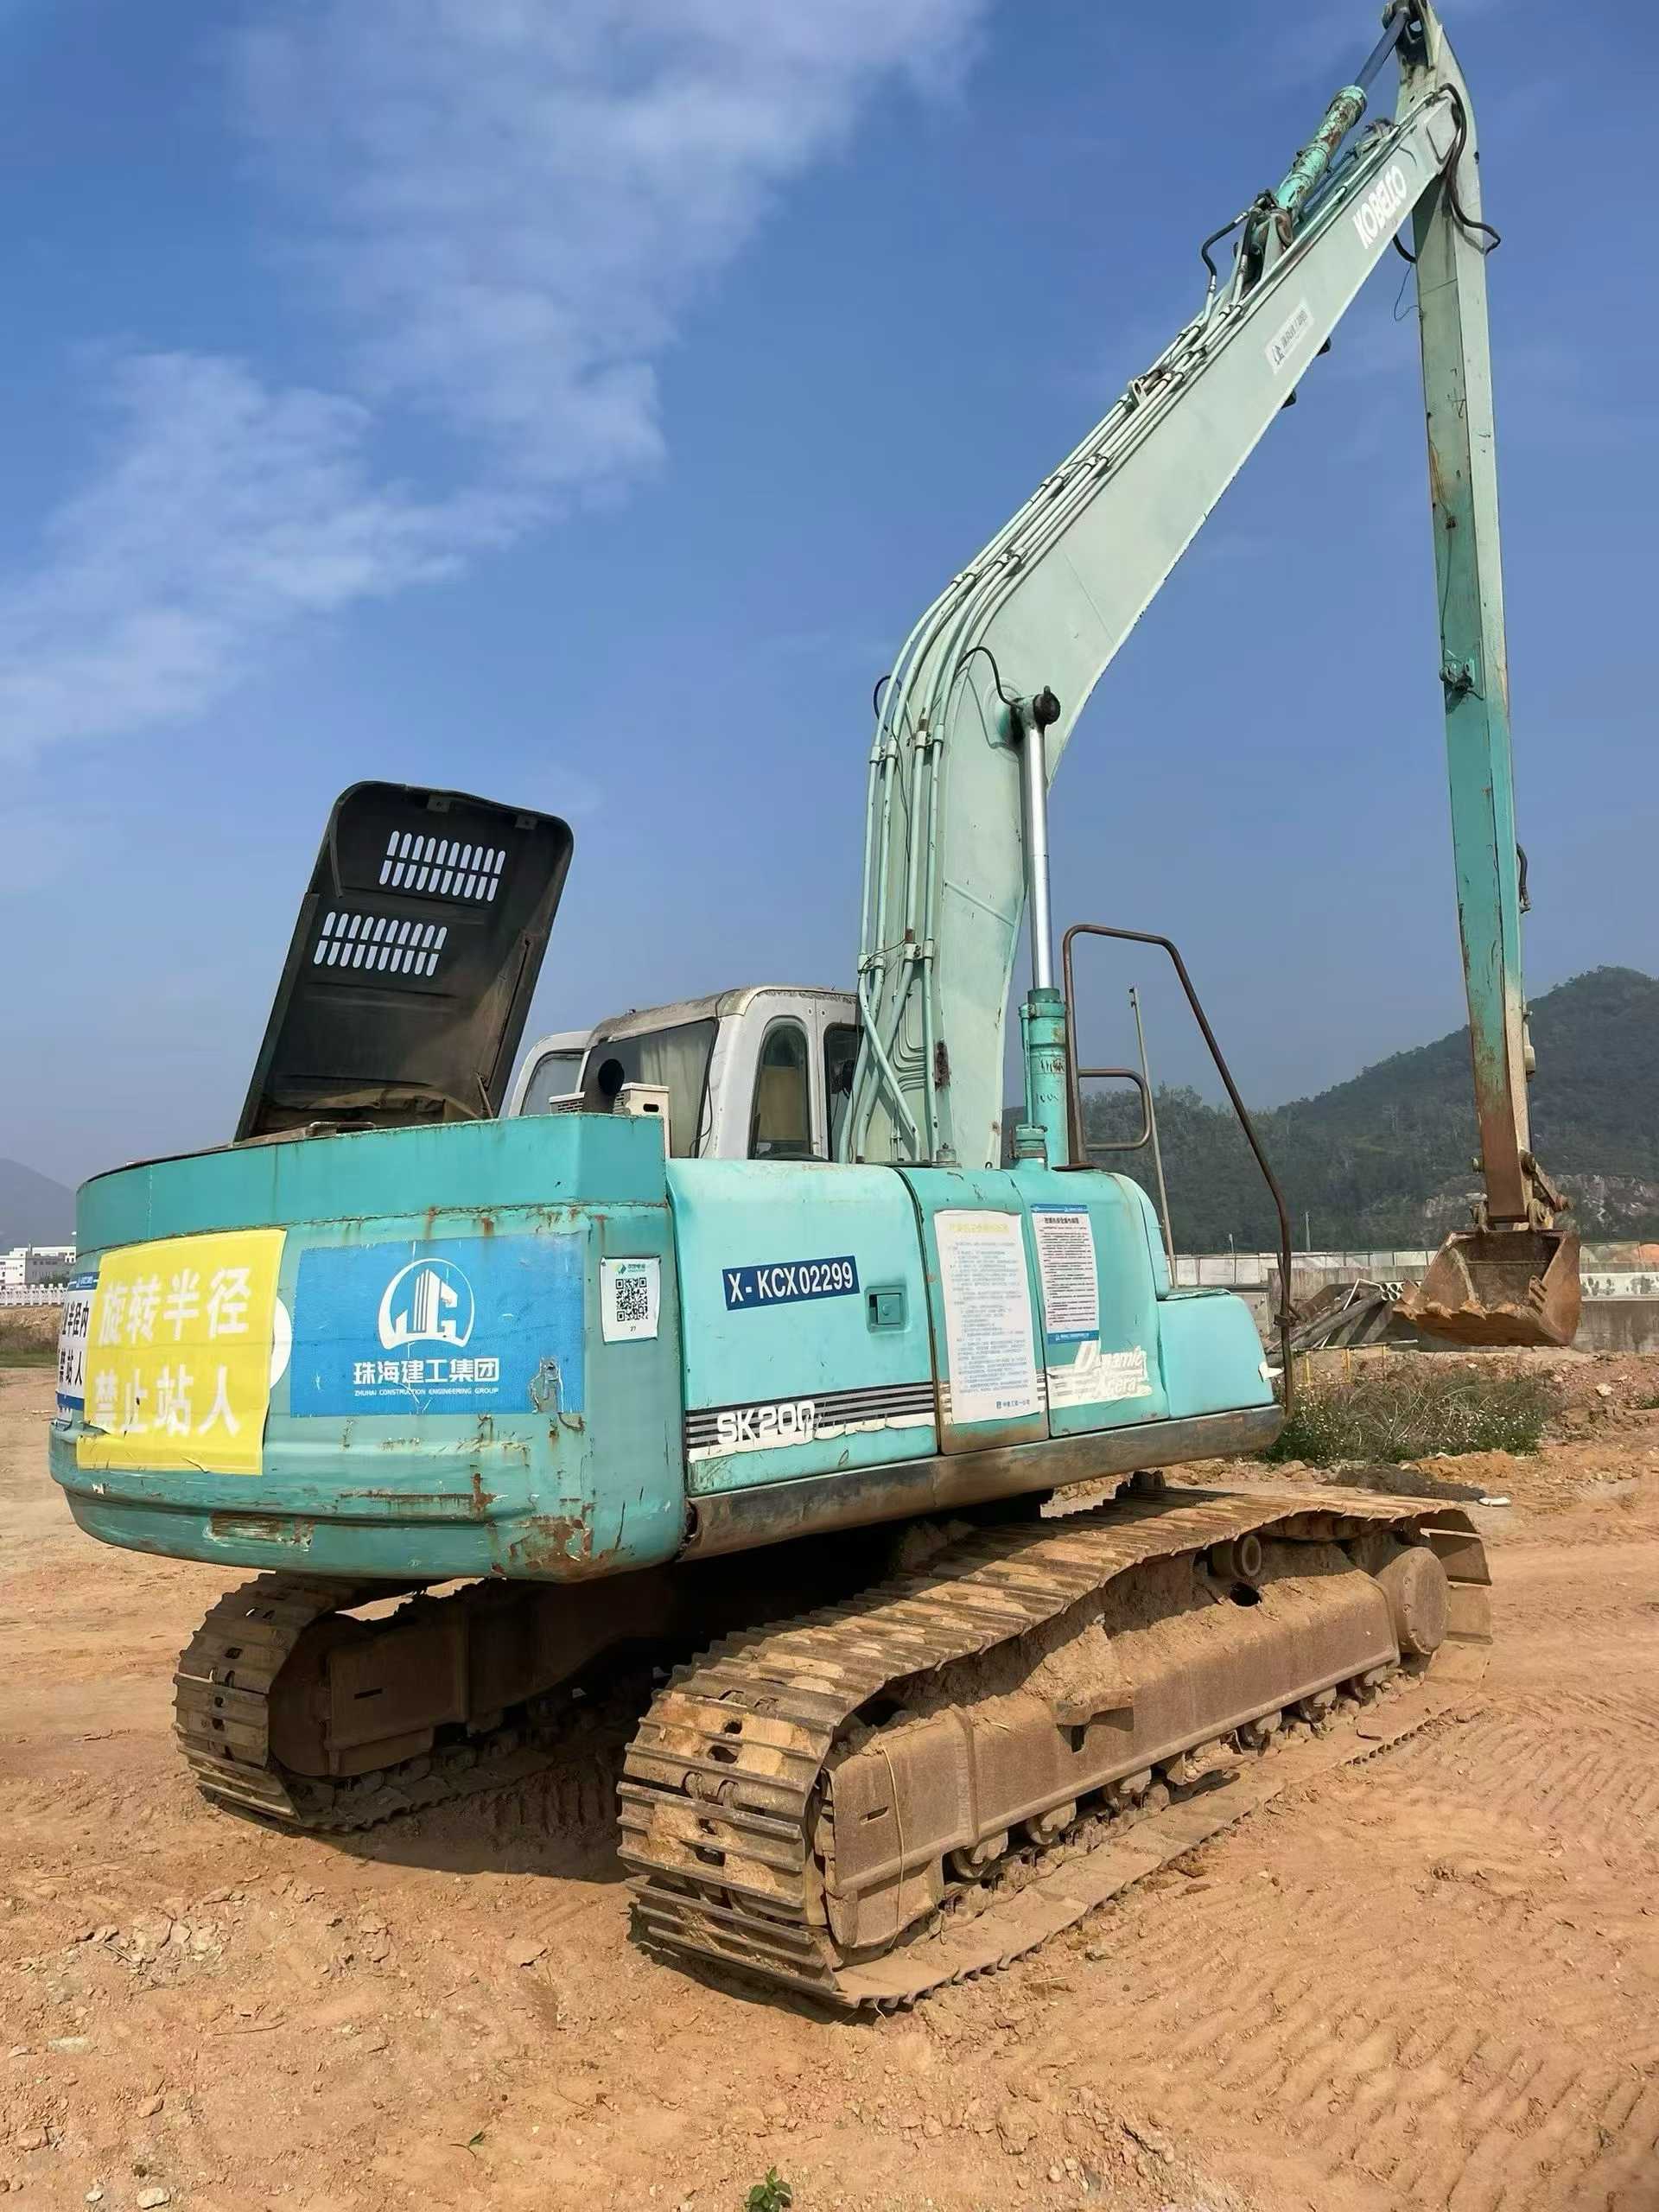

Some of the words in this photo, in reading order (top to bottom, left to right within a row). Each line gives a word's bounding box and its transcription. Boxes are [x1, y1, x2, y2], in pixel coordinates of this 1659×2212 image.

[99, 1268, 251, 1346] 旋转半径
[94, 1363, 242, 1437] 禁止站人
[353, 1357, 499, 1385] 珠海建工集团
[717, 1400, 815, 1444] SK200
